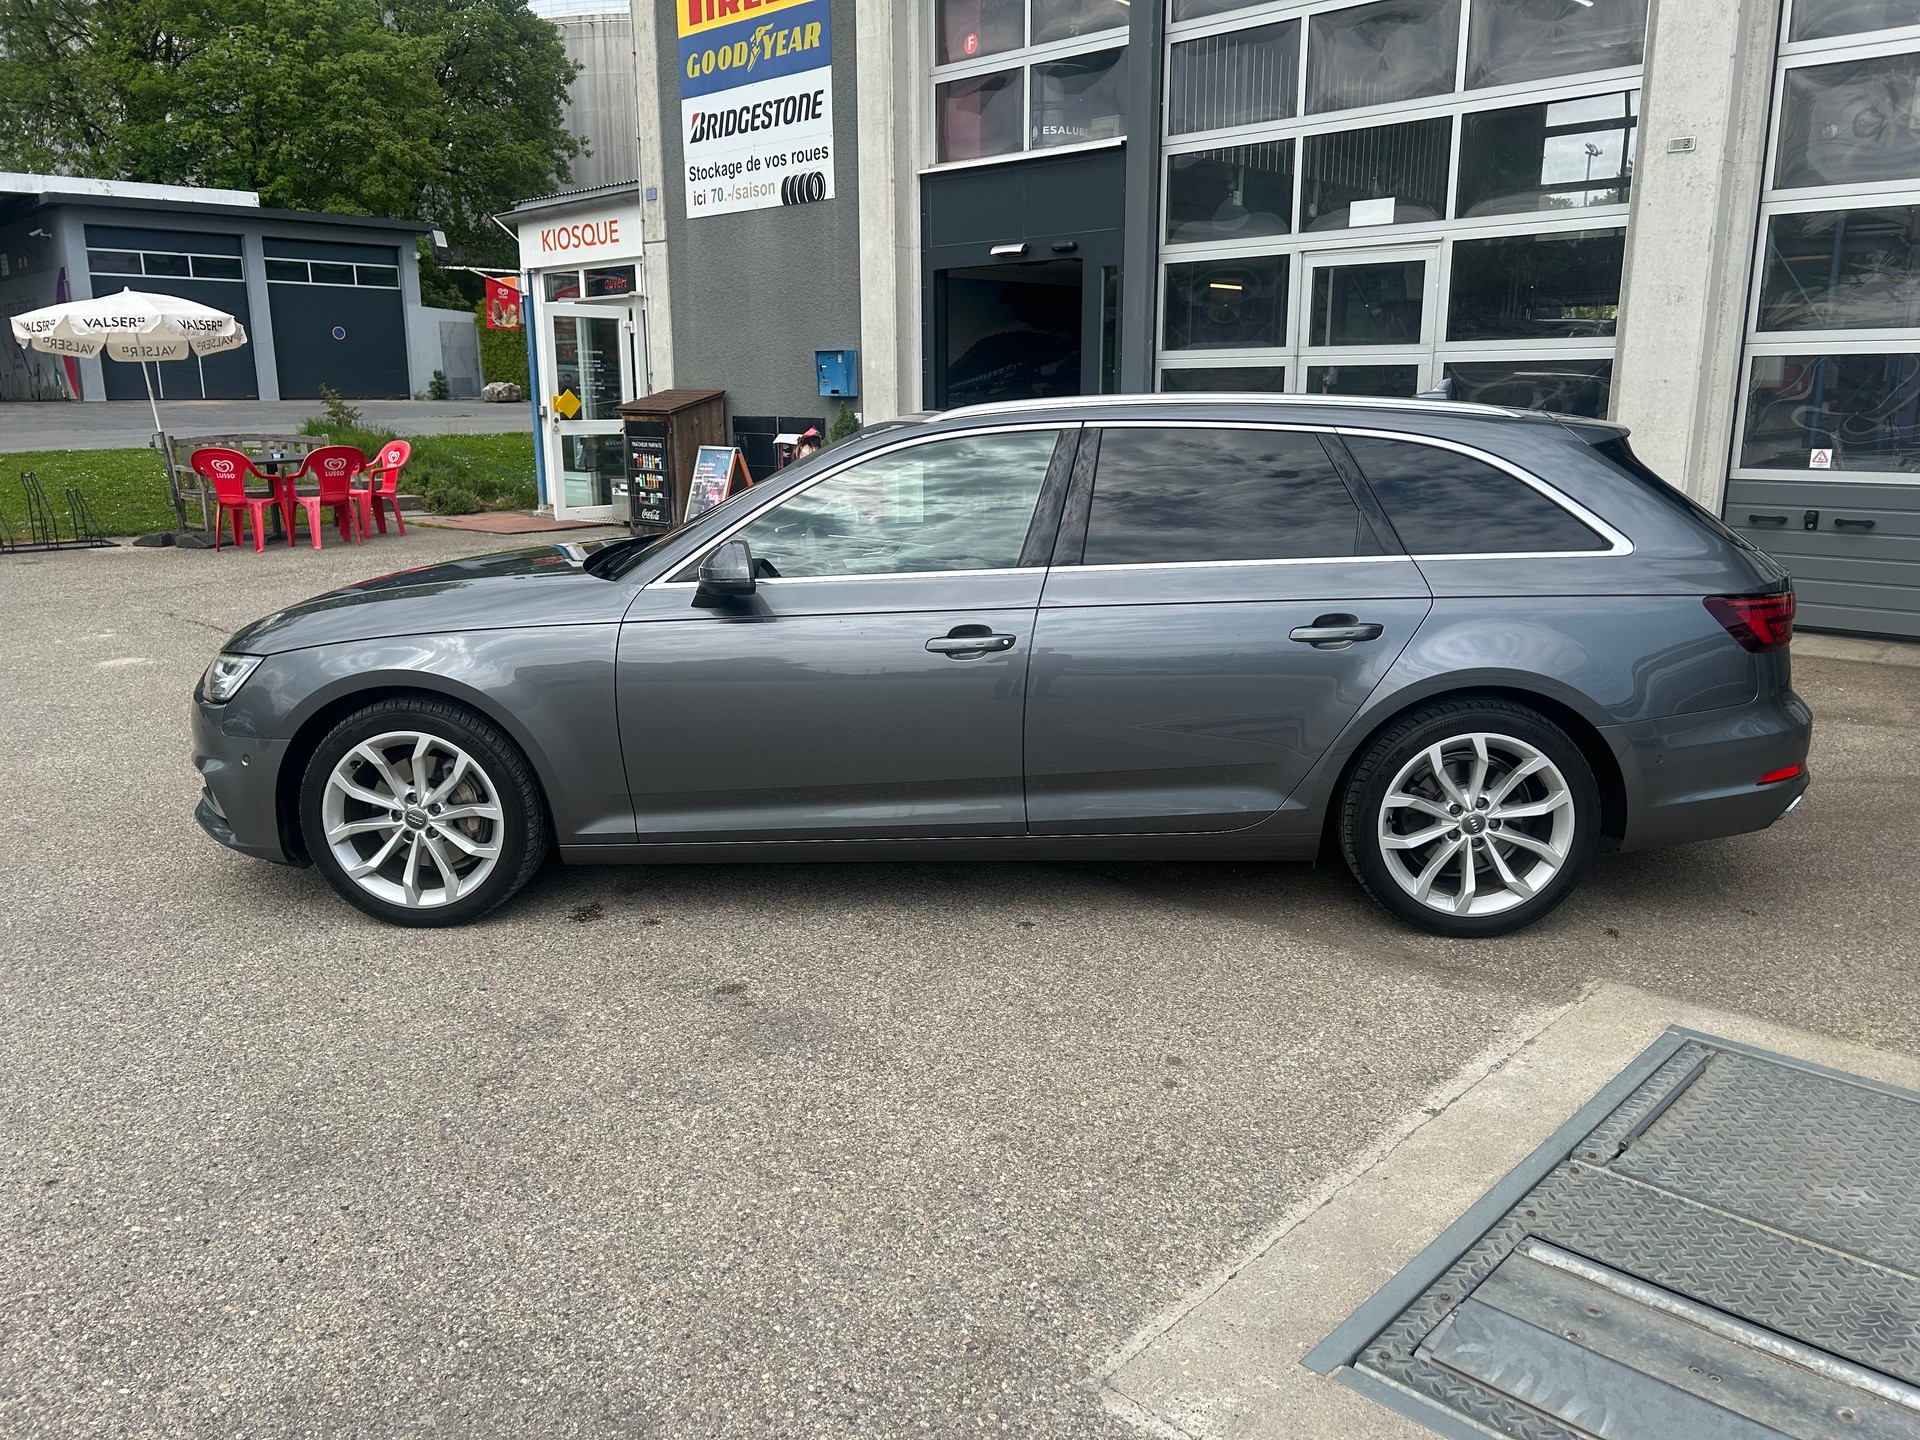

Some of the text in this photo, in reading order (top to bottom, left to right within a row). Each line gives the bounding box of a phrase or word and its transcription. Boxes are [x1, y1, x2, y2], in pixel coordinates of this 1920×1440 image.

[689, 89, 824, 144] BRIDGESTONE
[1042, 125, 1089, 137] ESALUBE
[1684, 139, 1690, 148] 5
[689, 145, 829, 182] Stockage de vos roues
[693, 189, 706, 206] ici
[541, 219, 620, 252] KIOSQUE
[83, 316, 137, 328] VALSER
[176, 319, 218, 332] VALSER
